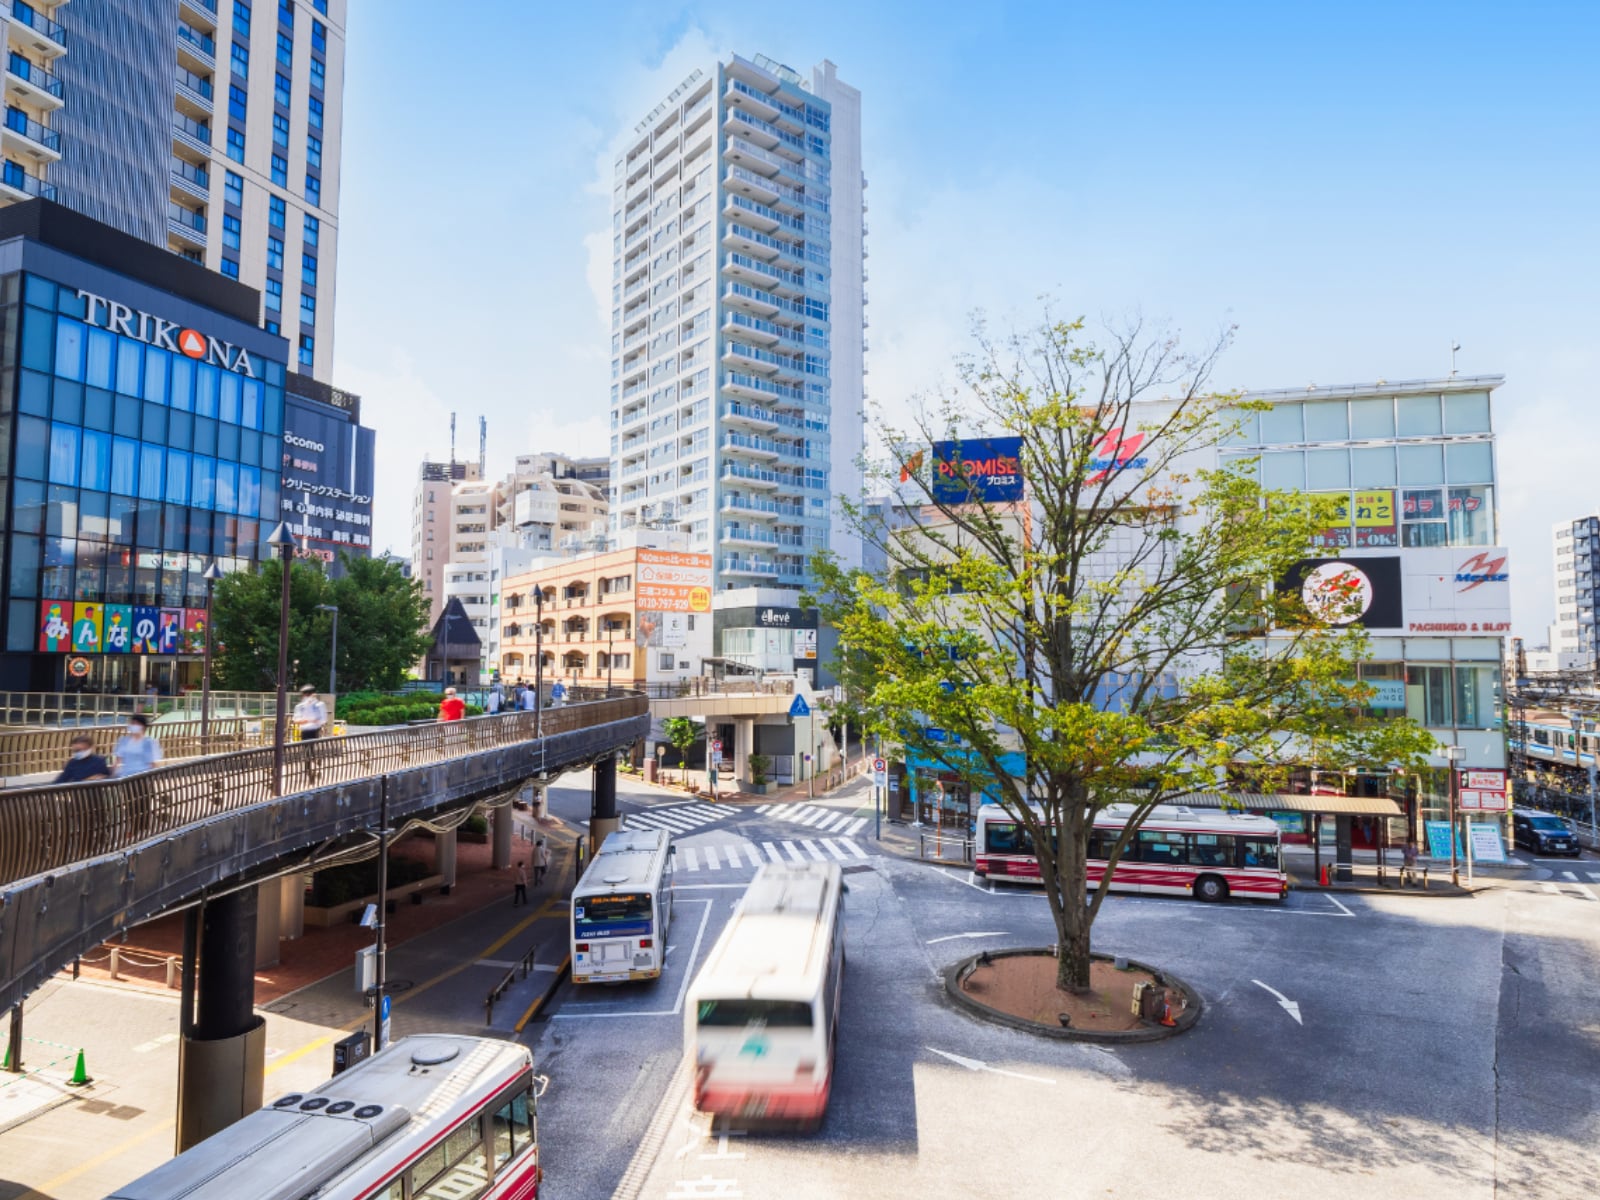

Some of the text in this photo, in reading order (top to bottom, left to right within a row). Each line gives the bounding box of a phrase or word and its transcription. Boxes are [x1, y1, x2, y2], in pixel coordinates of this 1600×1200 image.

[77, 289, 257, 379] TRIKONA
[283, 434, 325, 453] ocomo
[986, 475, 1017, 486] プロミス
[1409, 622, 1512, 632] PACHINKO & SLOT
